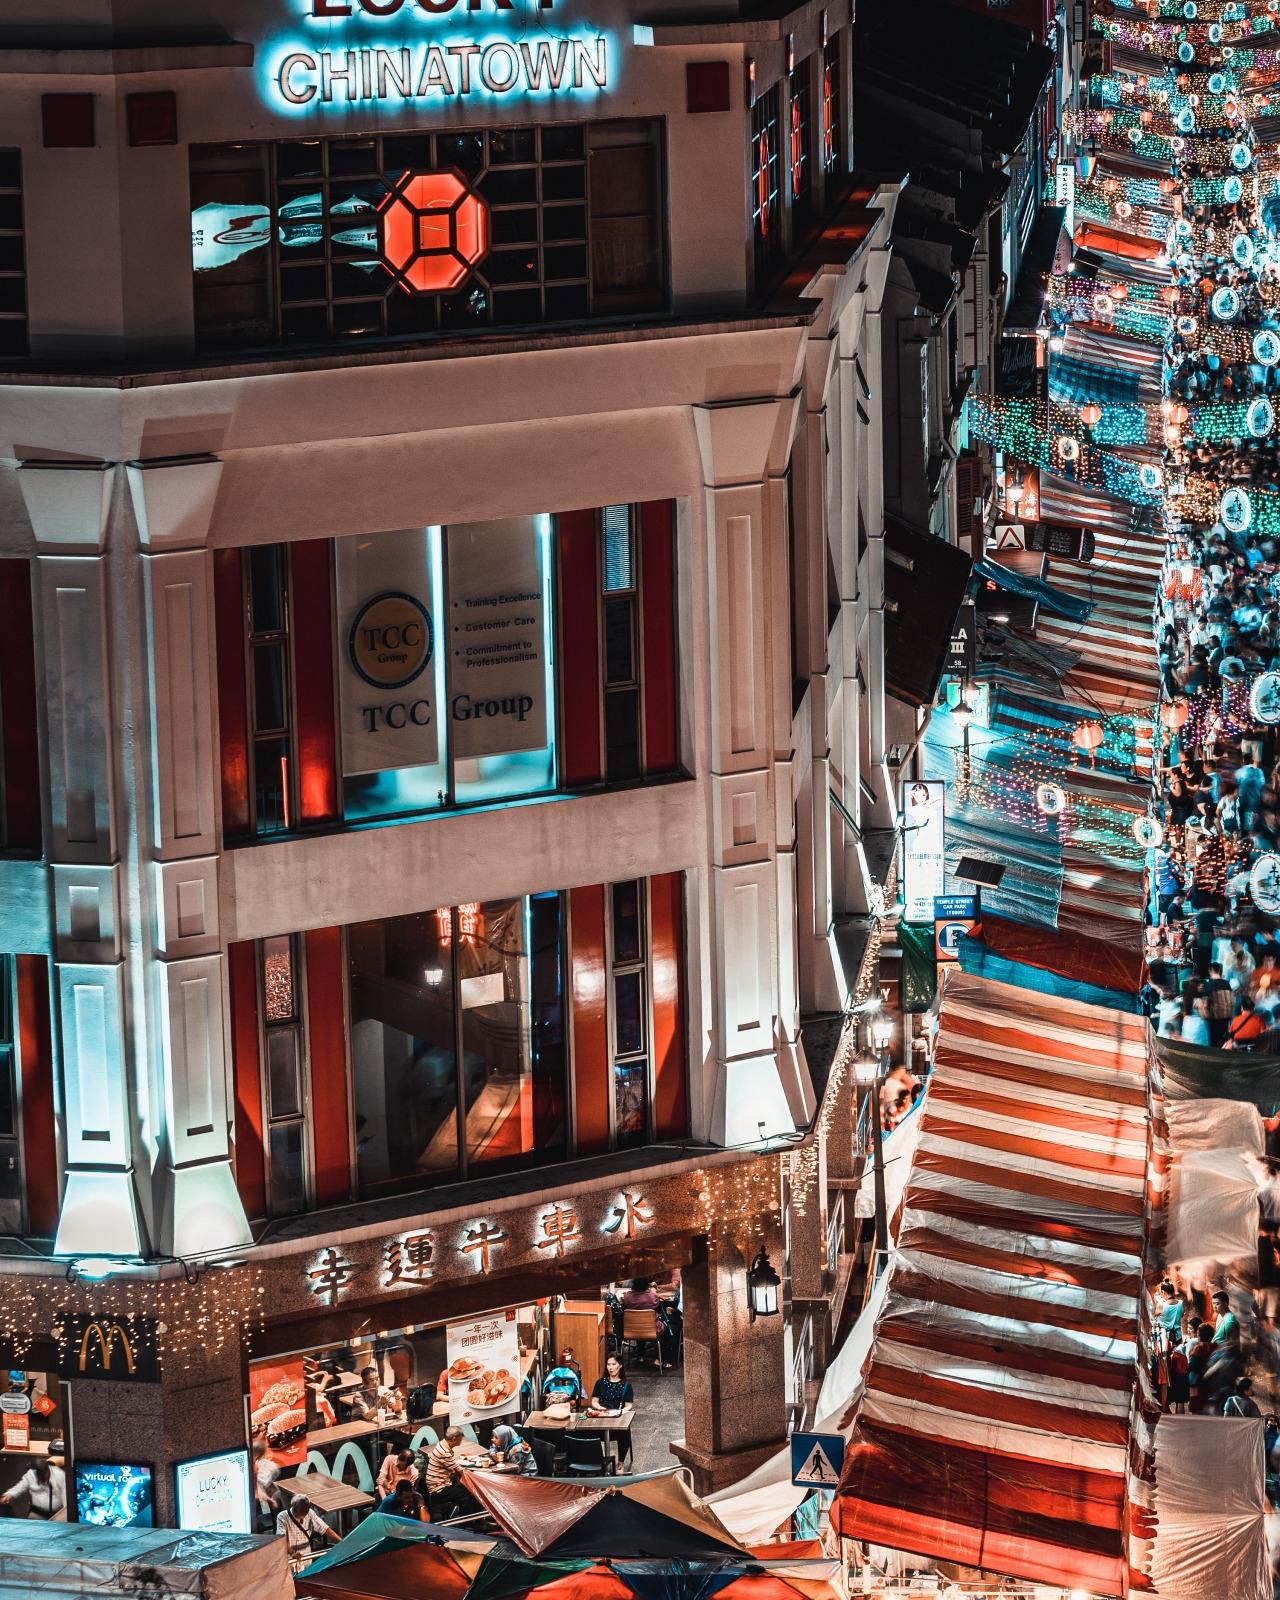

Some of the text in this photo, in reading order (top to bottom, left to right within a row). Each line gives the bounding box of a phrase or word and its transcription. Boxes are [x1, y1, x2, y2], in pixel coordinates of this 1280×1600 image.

[278, 38, 607, 104] CHINATOWN
[465, 592, 542, 608] Training Excellence
[465, 617, 536, 632] Customer Care
[363, 623, 420, 652] TCC
[466, 640, 532, 656] Commitment to
[377, 652, 408, 664] Group
[466, 652, 538, 668] Professionalism
[363, 694, 534, 732] TCC Group
[465, 1320, 499, 1333] 一年一次
[84, 1473, 116, 1482] virtual
[199, 1475, 228, 1492] LUCKY
